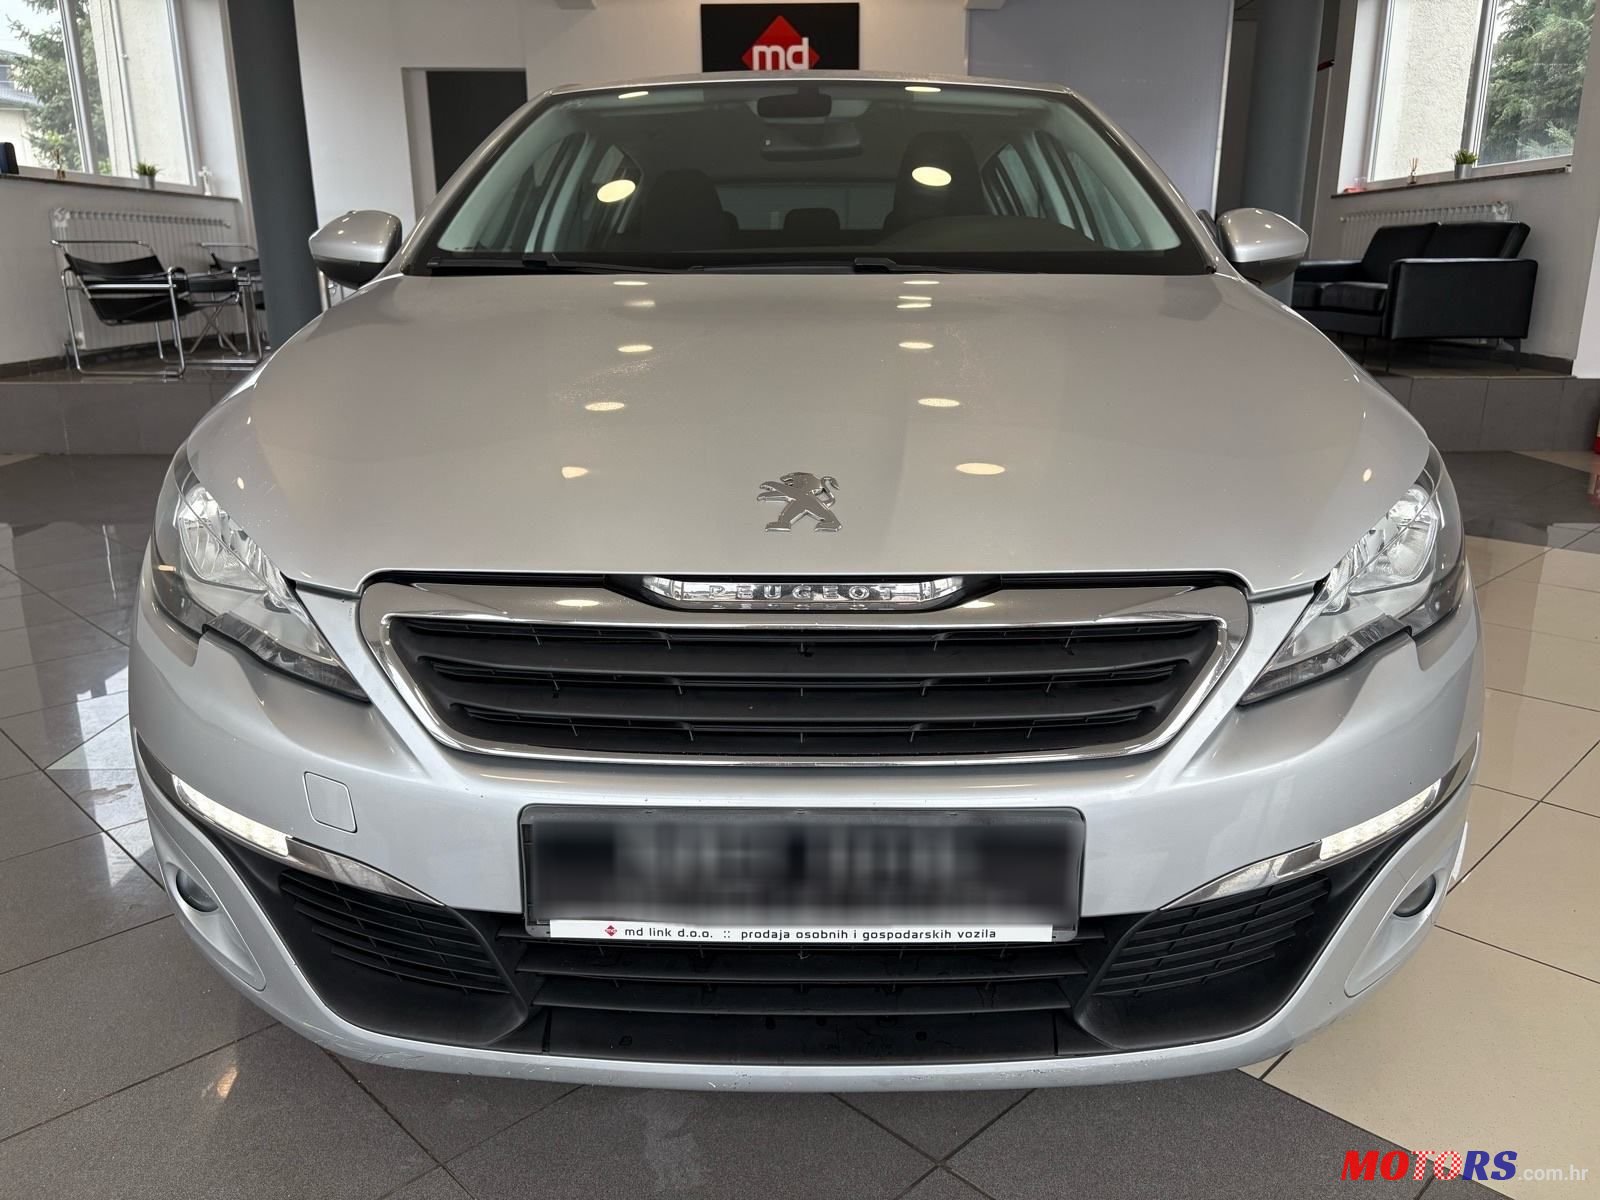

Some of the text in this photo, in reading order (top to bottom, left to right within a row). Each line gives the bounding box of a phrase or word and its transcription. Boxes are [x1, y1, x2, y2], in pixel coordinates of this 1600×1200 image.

[752, 37, 810, 71] md
[708, 584, 897, 601] PEUGEOT
[625, 927, 643, 937] md
[649, 927, 672, 938] link
[677, 929, 713, 939] d.o.o.
[741, 930, 790, 941] prodaja
[796, 930, 848, 940] osobnih
[853, 930, 857, 940] i
[862, 930, 952, 941] gospodarskih
[957, 929, 996, 939] vozila
